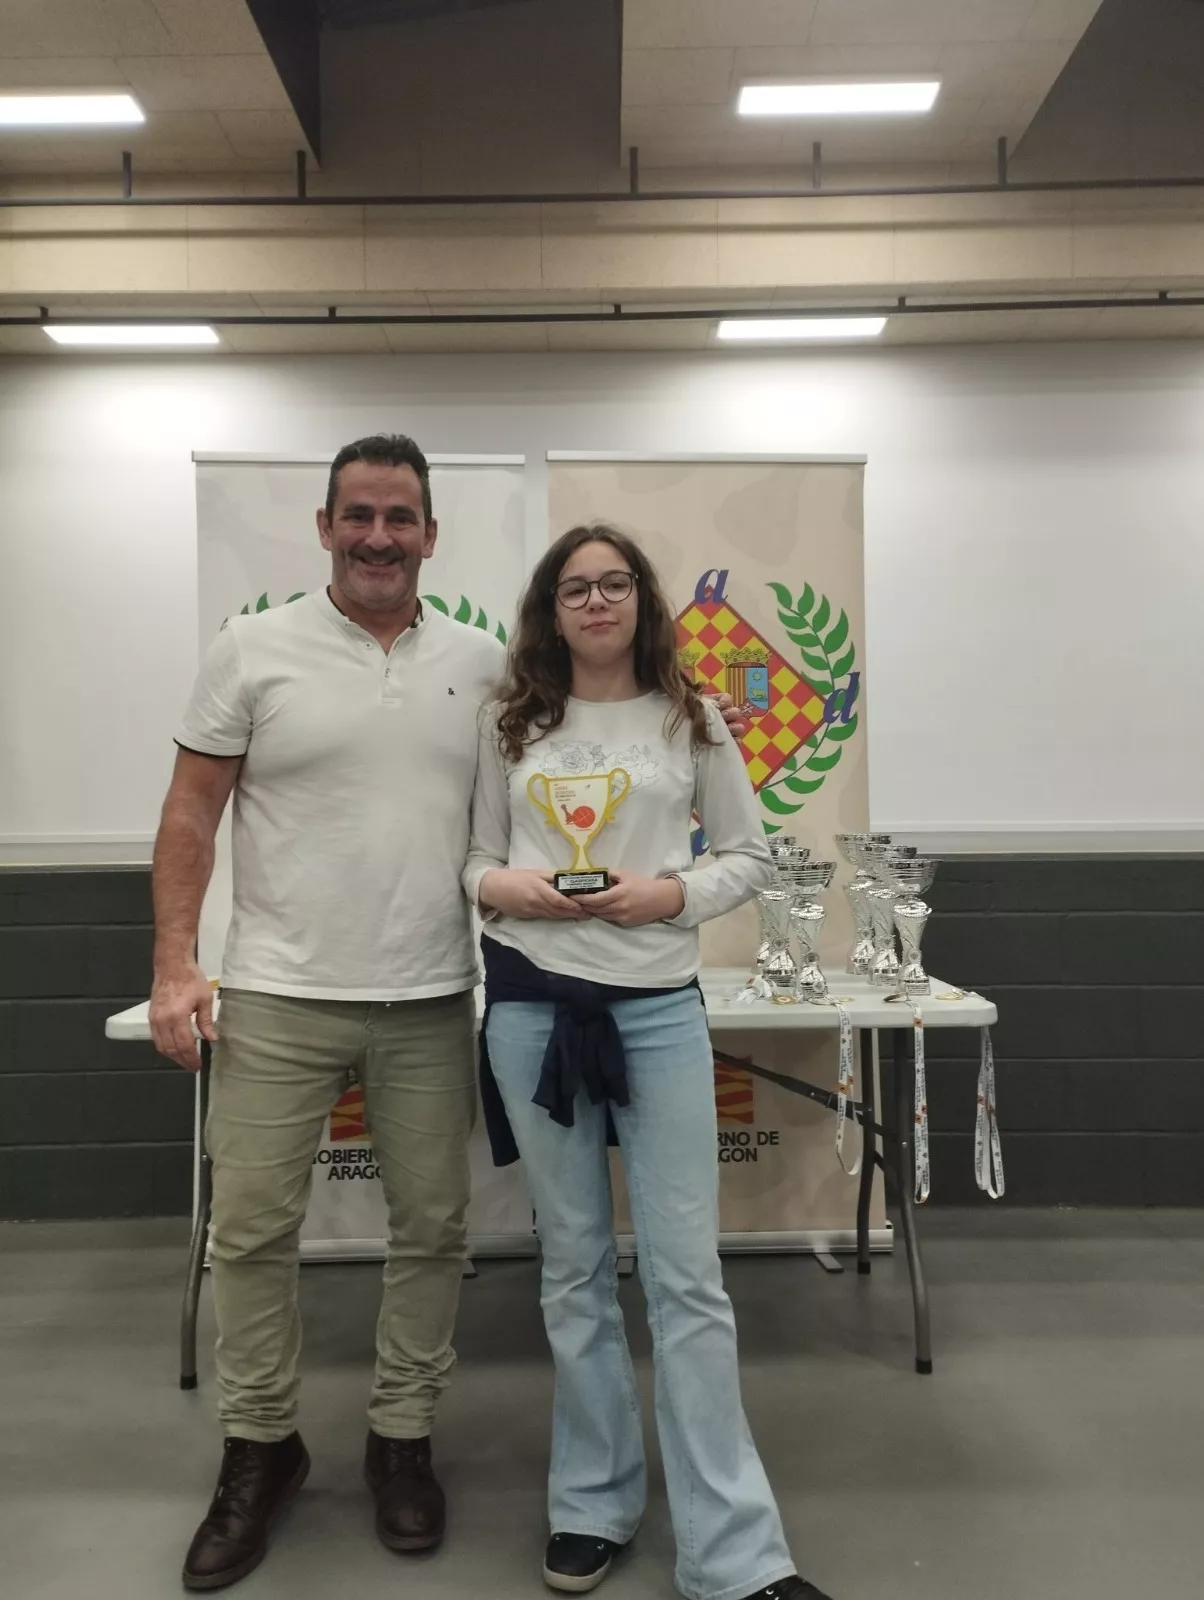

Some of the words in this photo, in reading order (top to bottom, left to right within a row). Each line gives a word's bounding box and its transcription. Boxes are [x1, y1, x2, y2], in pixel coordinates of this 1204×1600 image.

[694, 568, 730, 604] a
[823, 671, 861, 724] d
[757, 1131, 780, 1146] DE
